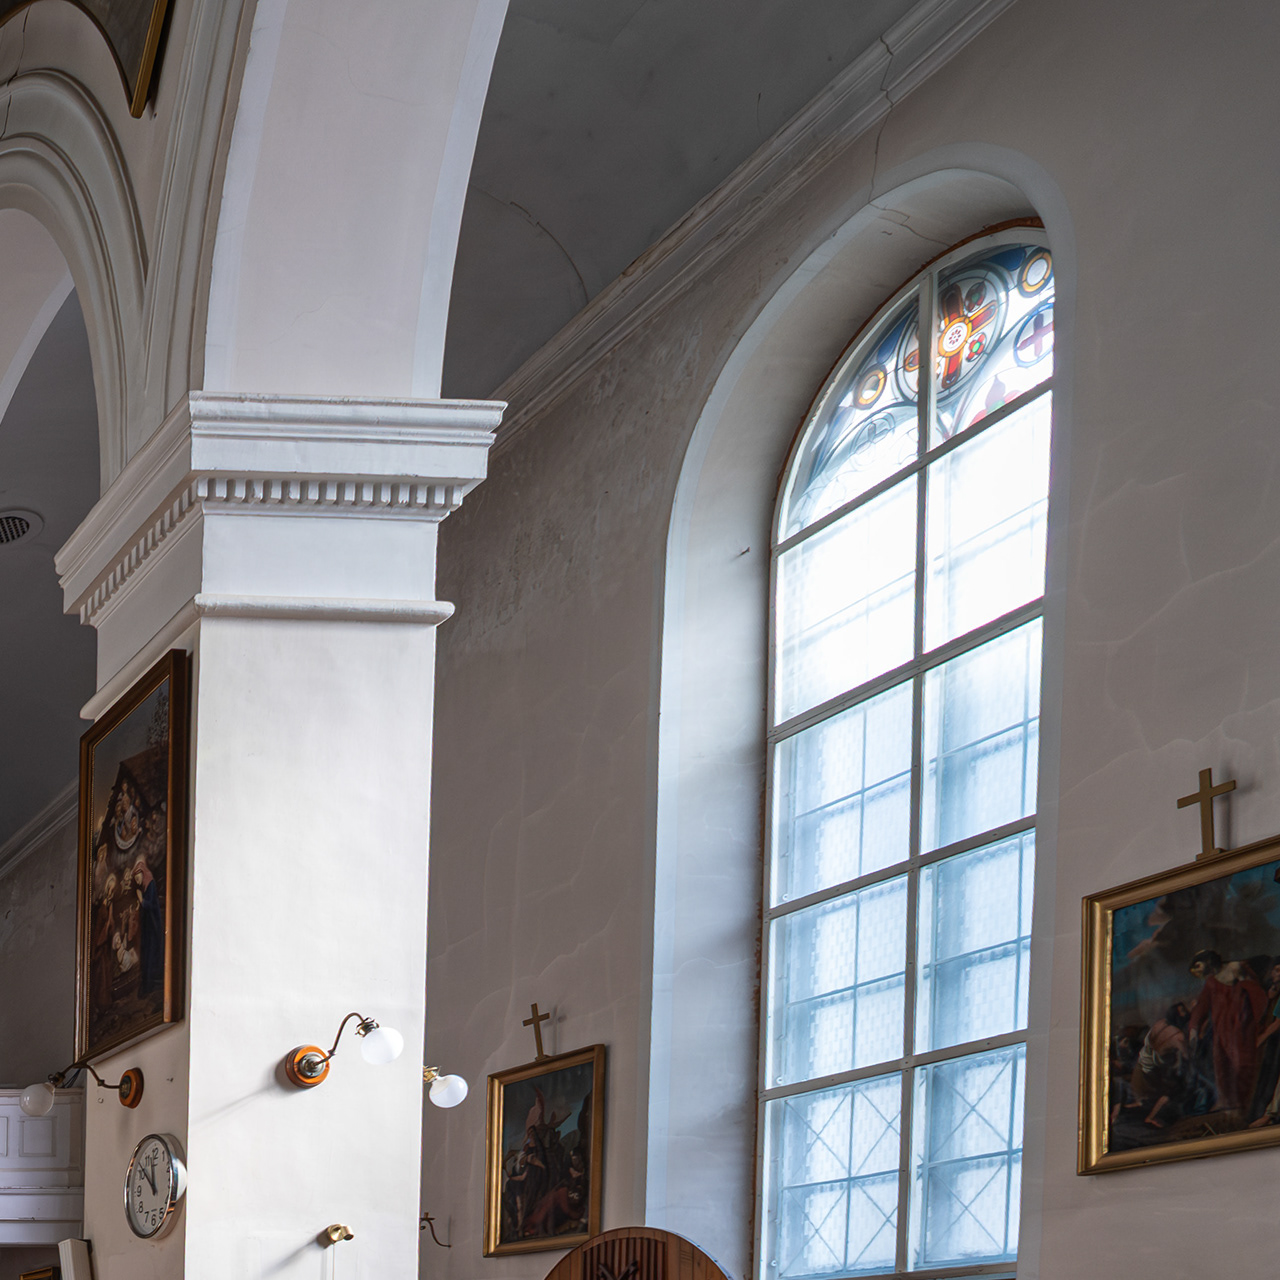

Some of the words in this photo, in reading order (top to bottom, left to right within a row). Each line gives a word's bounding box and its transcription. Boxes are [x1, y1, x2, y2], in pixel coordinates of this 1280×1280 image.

[152, 1147, 159, 1160] 12
[161, 1151, 166, 1162] 1
[144, 1154, 150, 1167] 11
[137, 1168, 146, 1181] 10
[136, 1185, 142, 1197] 9
[138, 1201, 144, 1213] 8
[144, 1211, 150, 1223] 7
[158, 1207, 165, 1220] 5
[151, 1214, 157, 1226] 6
